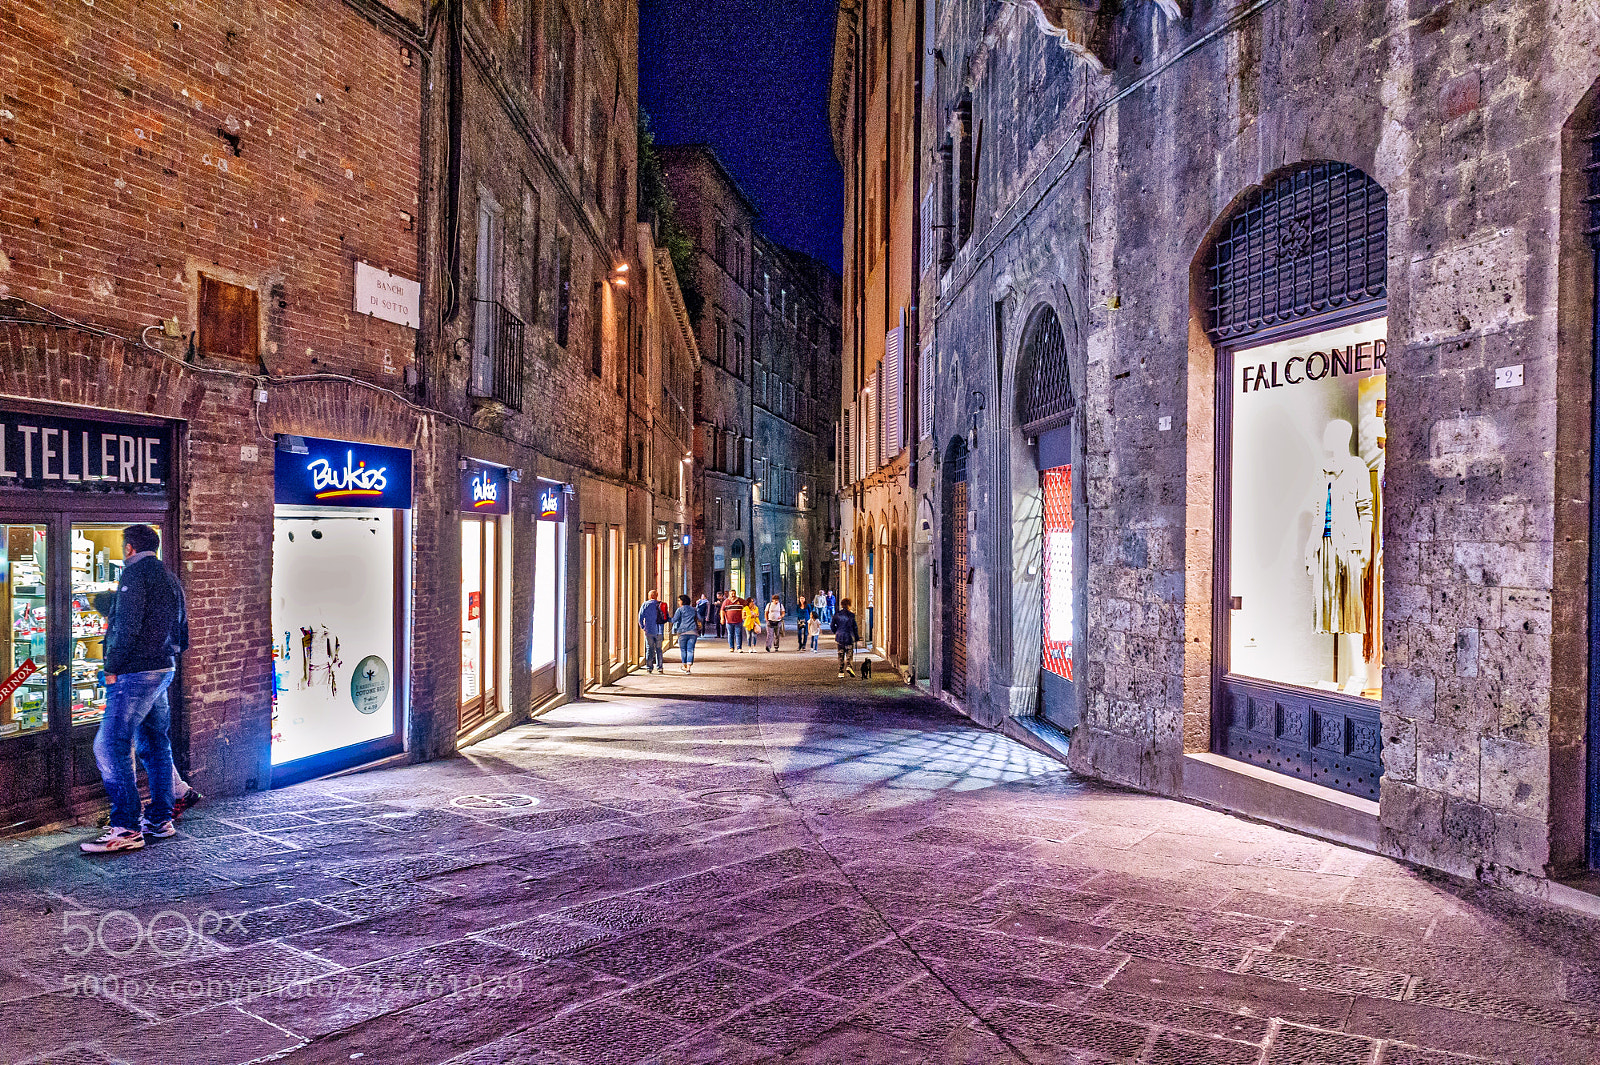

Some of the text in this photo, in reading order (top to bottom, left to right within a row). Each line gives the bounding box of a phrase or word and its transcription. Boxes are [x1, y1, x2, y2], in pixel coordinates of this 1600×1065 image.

[376, 279, 404, 296] BANCHI
[370, 295, 409, 315] DI SOTTO
[1505, 369, 1513, 384] 2
[247, 449, 253, 459] 3
